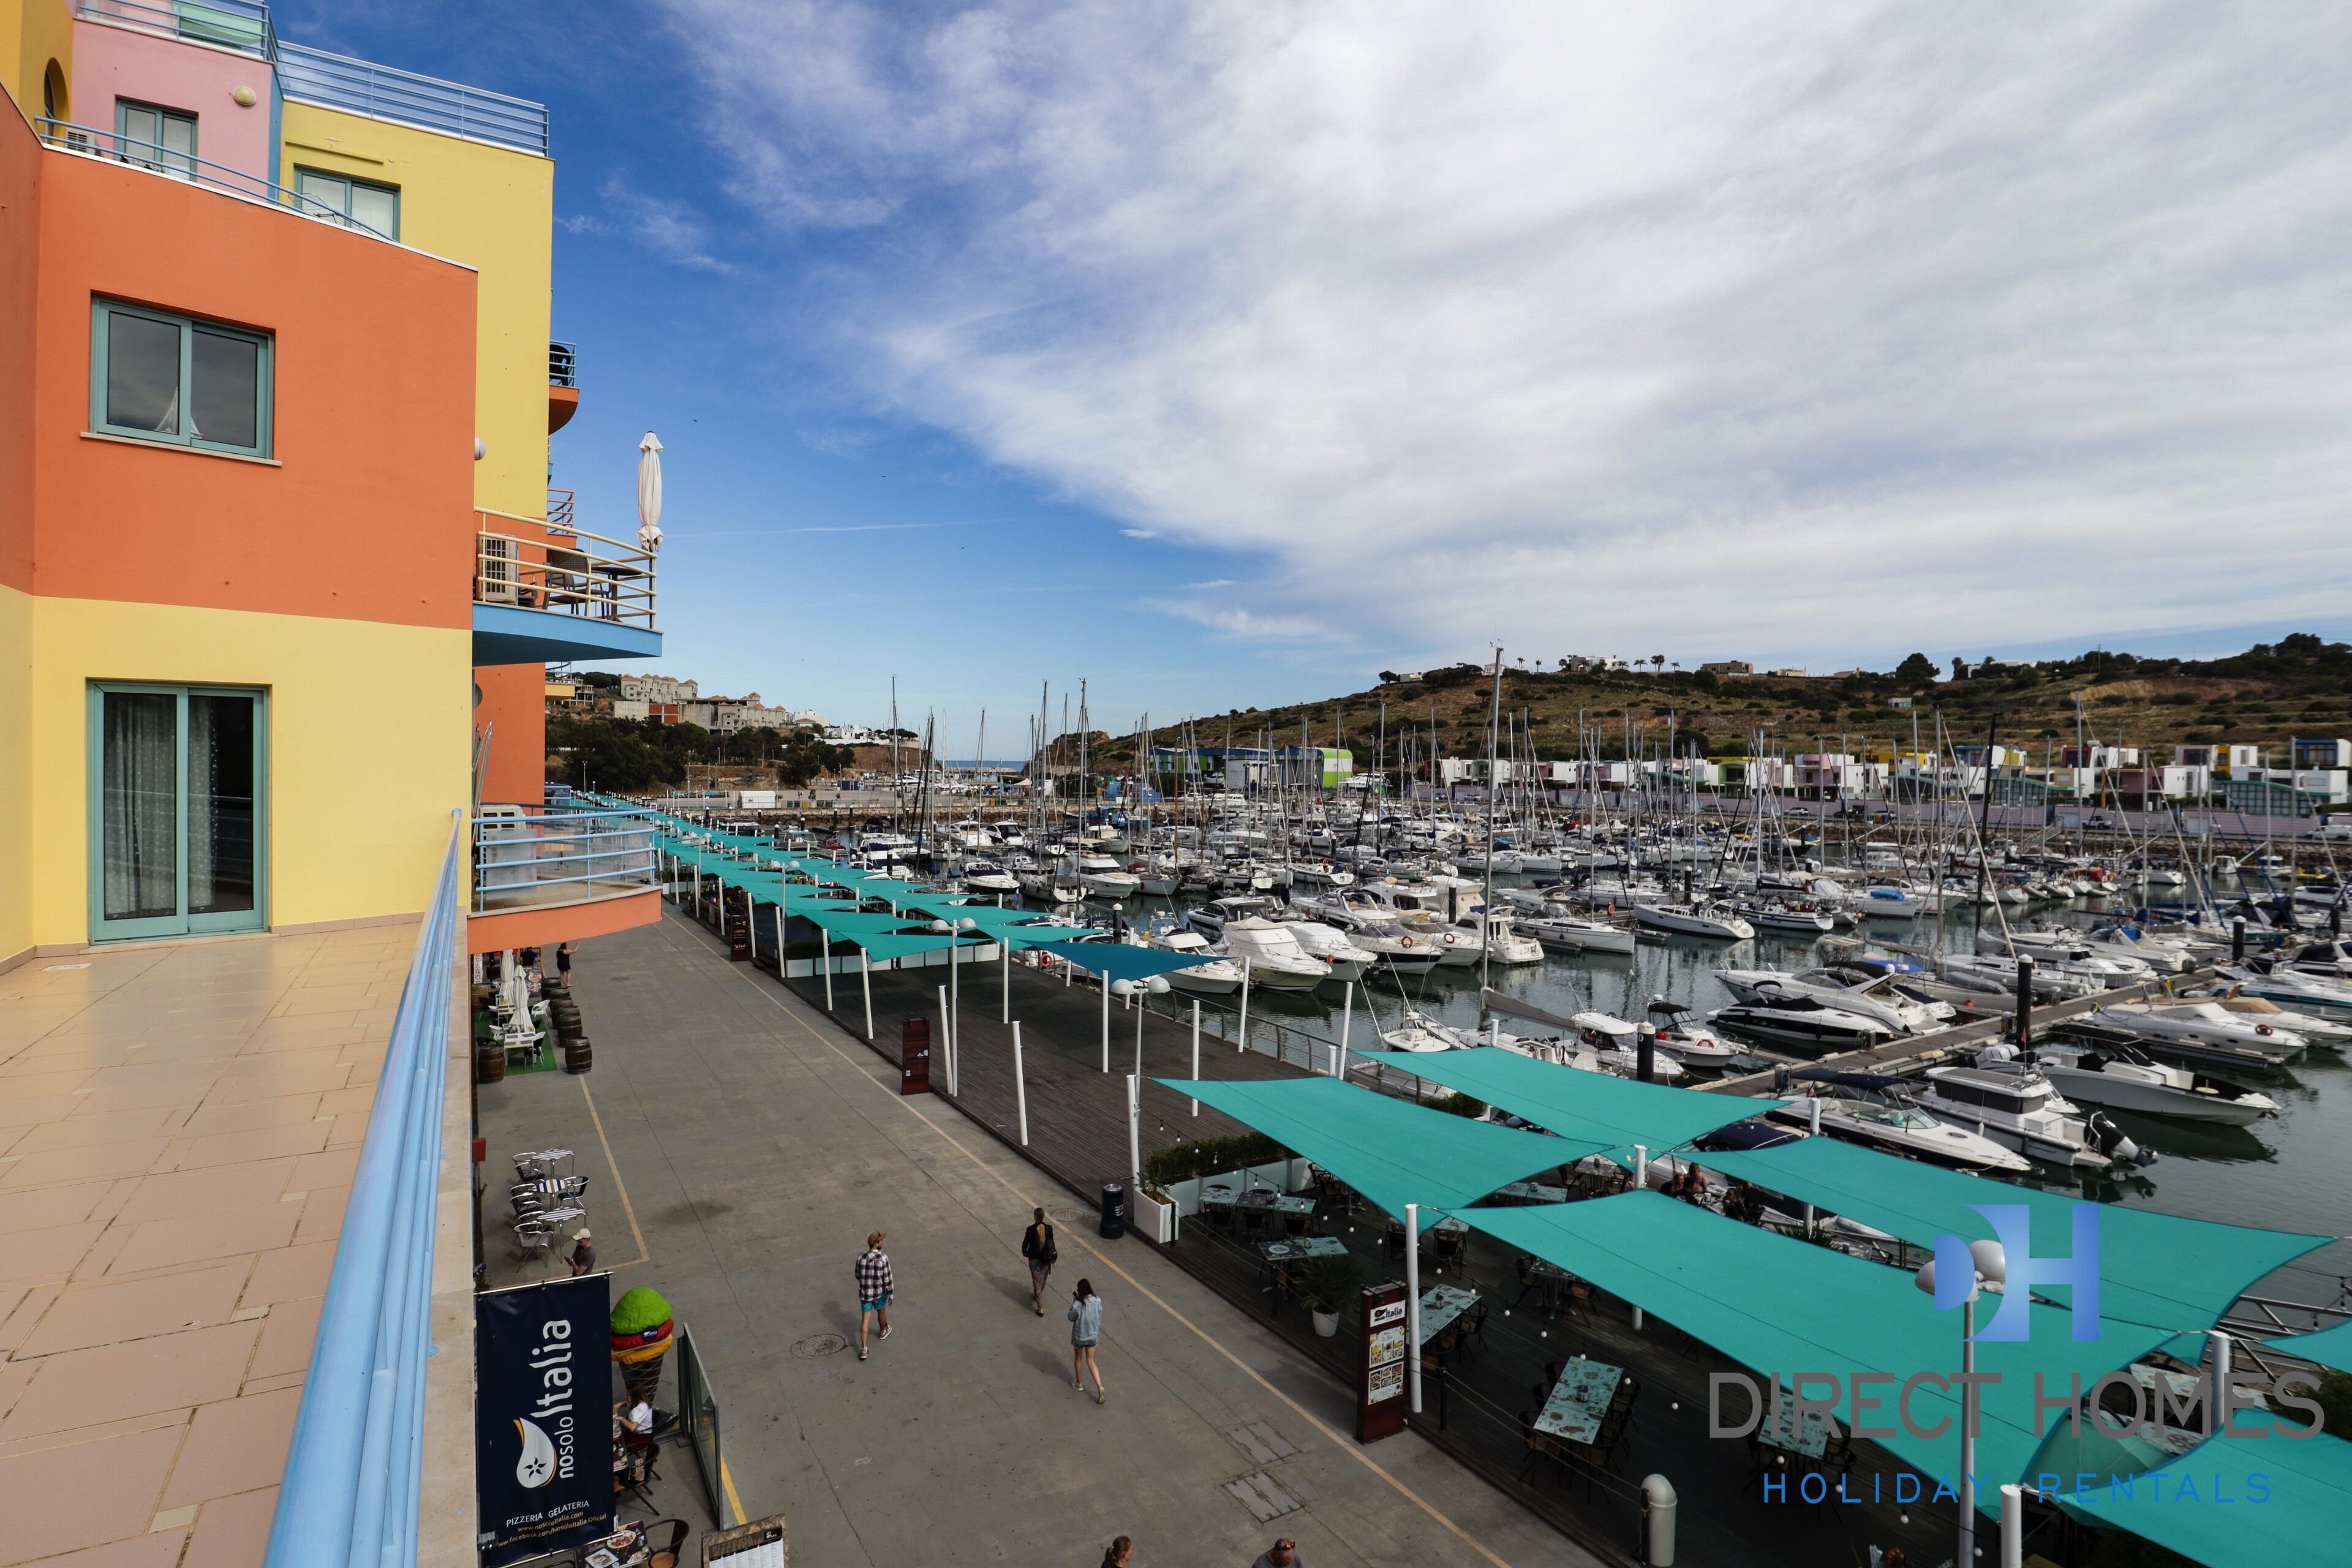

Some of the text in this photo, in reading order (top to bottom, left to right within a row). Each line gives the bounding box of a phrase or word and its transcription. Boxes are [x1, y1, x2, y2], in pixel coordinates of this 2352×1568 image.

[1385, 1307, 1403, 1318] Italia
[529, 1319, 575, 1479] nosolo Italia
[506, 1500, 590, 1528] PIZZERIA GELATERIA
[516, 1510, 584, 1532] www.nosoloitalia.com
[497, 1513, 607, 1547] ww.facebook.com/NosoloItalia.Oficial
